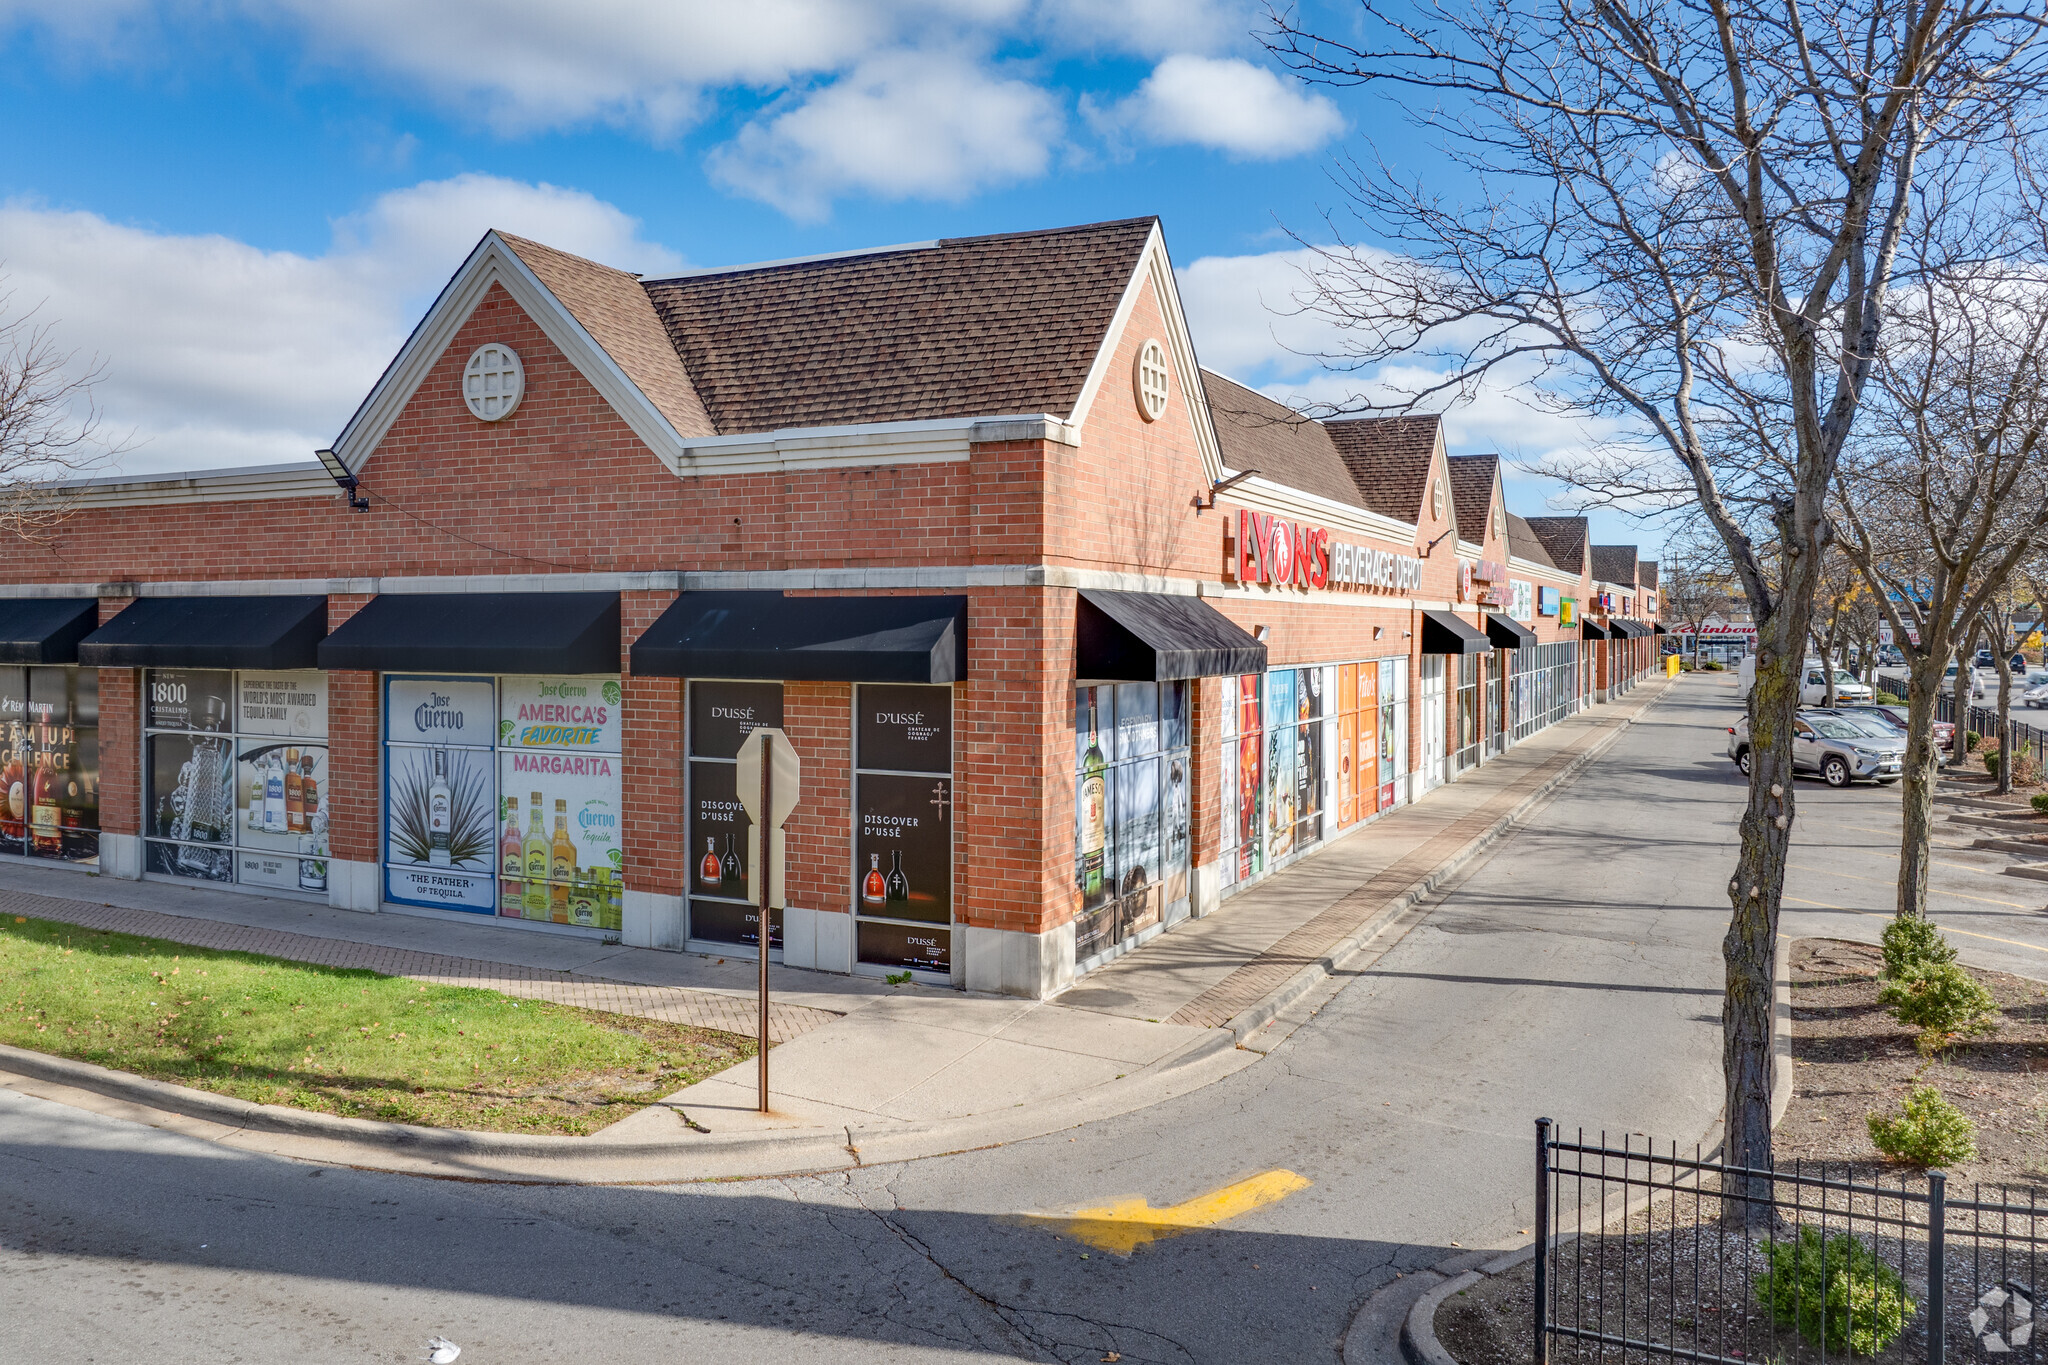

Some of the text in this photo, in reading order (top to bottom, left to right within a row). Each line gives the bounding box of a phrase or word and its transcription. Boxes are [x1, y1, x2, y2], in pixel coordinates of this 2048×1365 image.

[1235, 510, 1328, 588] LYON'S
[1335, 542, 1393, 587] BEVERAGE
[1396, 553, 1424, 590] DEPOT
[243, 680, 265, 689] EXPERIENCE
[273, 681, 283, 690] TASTE
[284, 682, 289, 690] OF
[538, 681, 587, 699] Jose Cuervo
[1359, 671, 1376, 698] Tito's
[151, 682, 187, 704] 1800
[243, 691, 316, 706] WORLD'S MOST AWARDED
[430, 691, 451, 709] Jose
[28, 701, 54, 713] MARTIN
[151, 705, 188, 714] CRISTALINO
[243, 706, 287, 720] TEQUILA FAMILY
[518, 703, 608, 725] AMERICA'S
[711, 706, 755, 720] D'USSÉ
[414, 702, 464, 733] Cuervo
[876, 711, 925, 725] D'USSÉ
[520, 726, 602, 744] FAVORITE
[514, 754, 611, 776] MARGARITA
[701, 800, 744, 811] DISCOVE
[578, 807, 615, 829] Cuervo
[701, 811, 734, 822] D'USSÉ
[864, 814, 919, 827] DISCOVER
[864, 826, 901, 838] D'USSÉ
[244, 860, 260, 870] 1800
[410, 873, 469, 888] THE FATHER
[416, 886, 428, 894] OF
[907, 936, 938, 947] D'USSÉ
